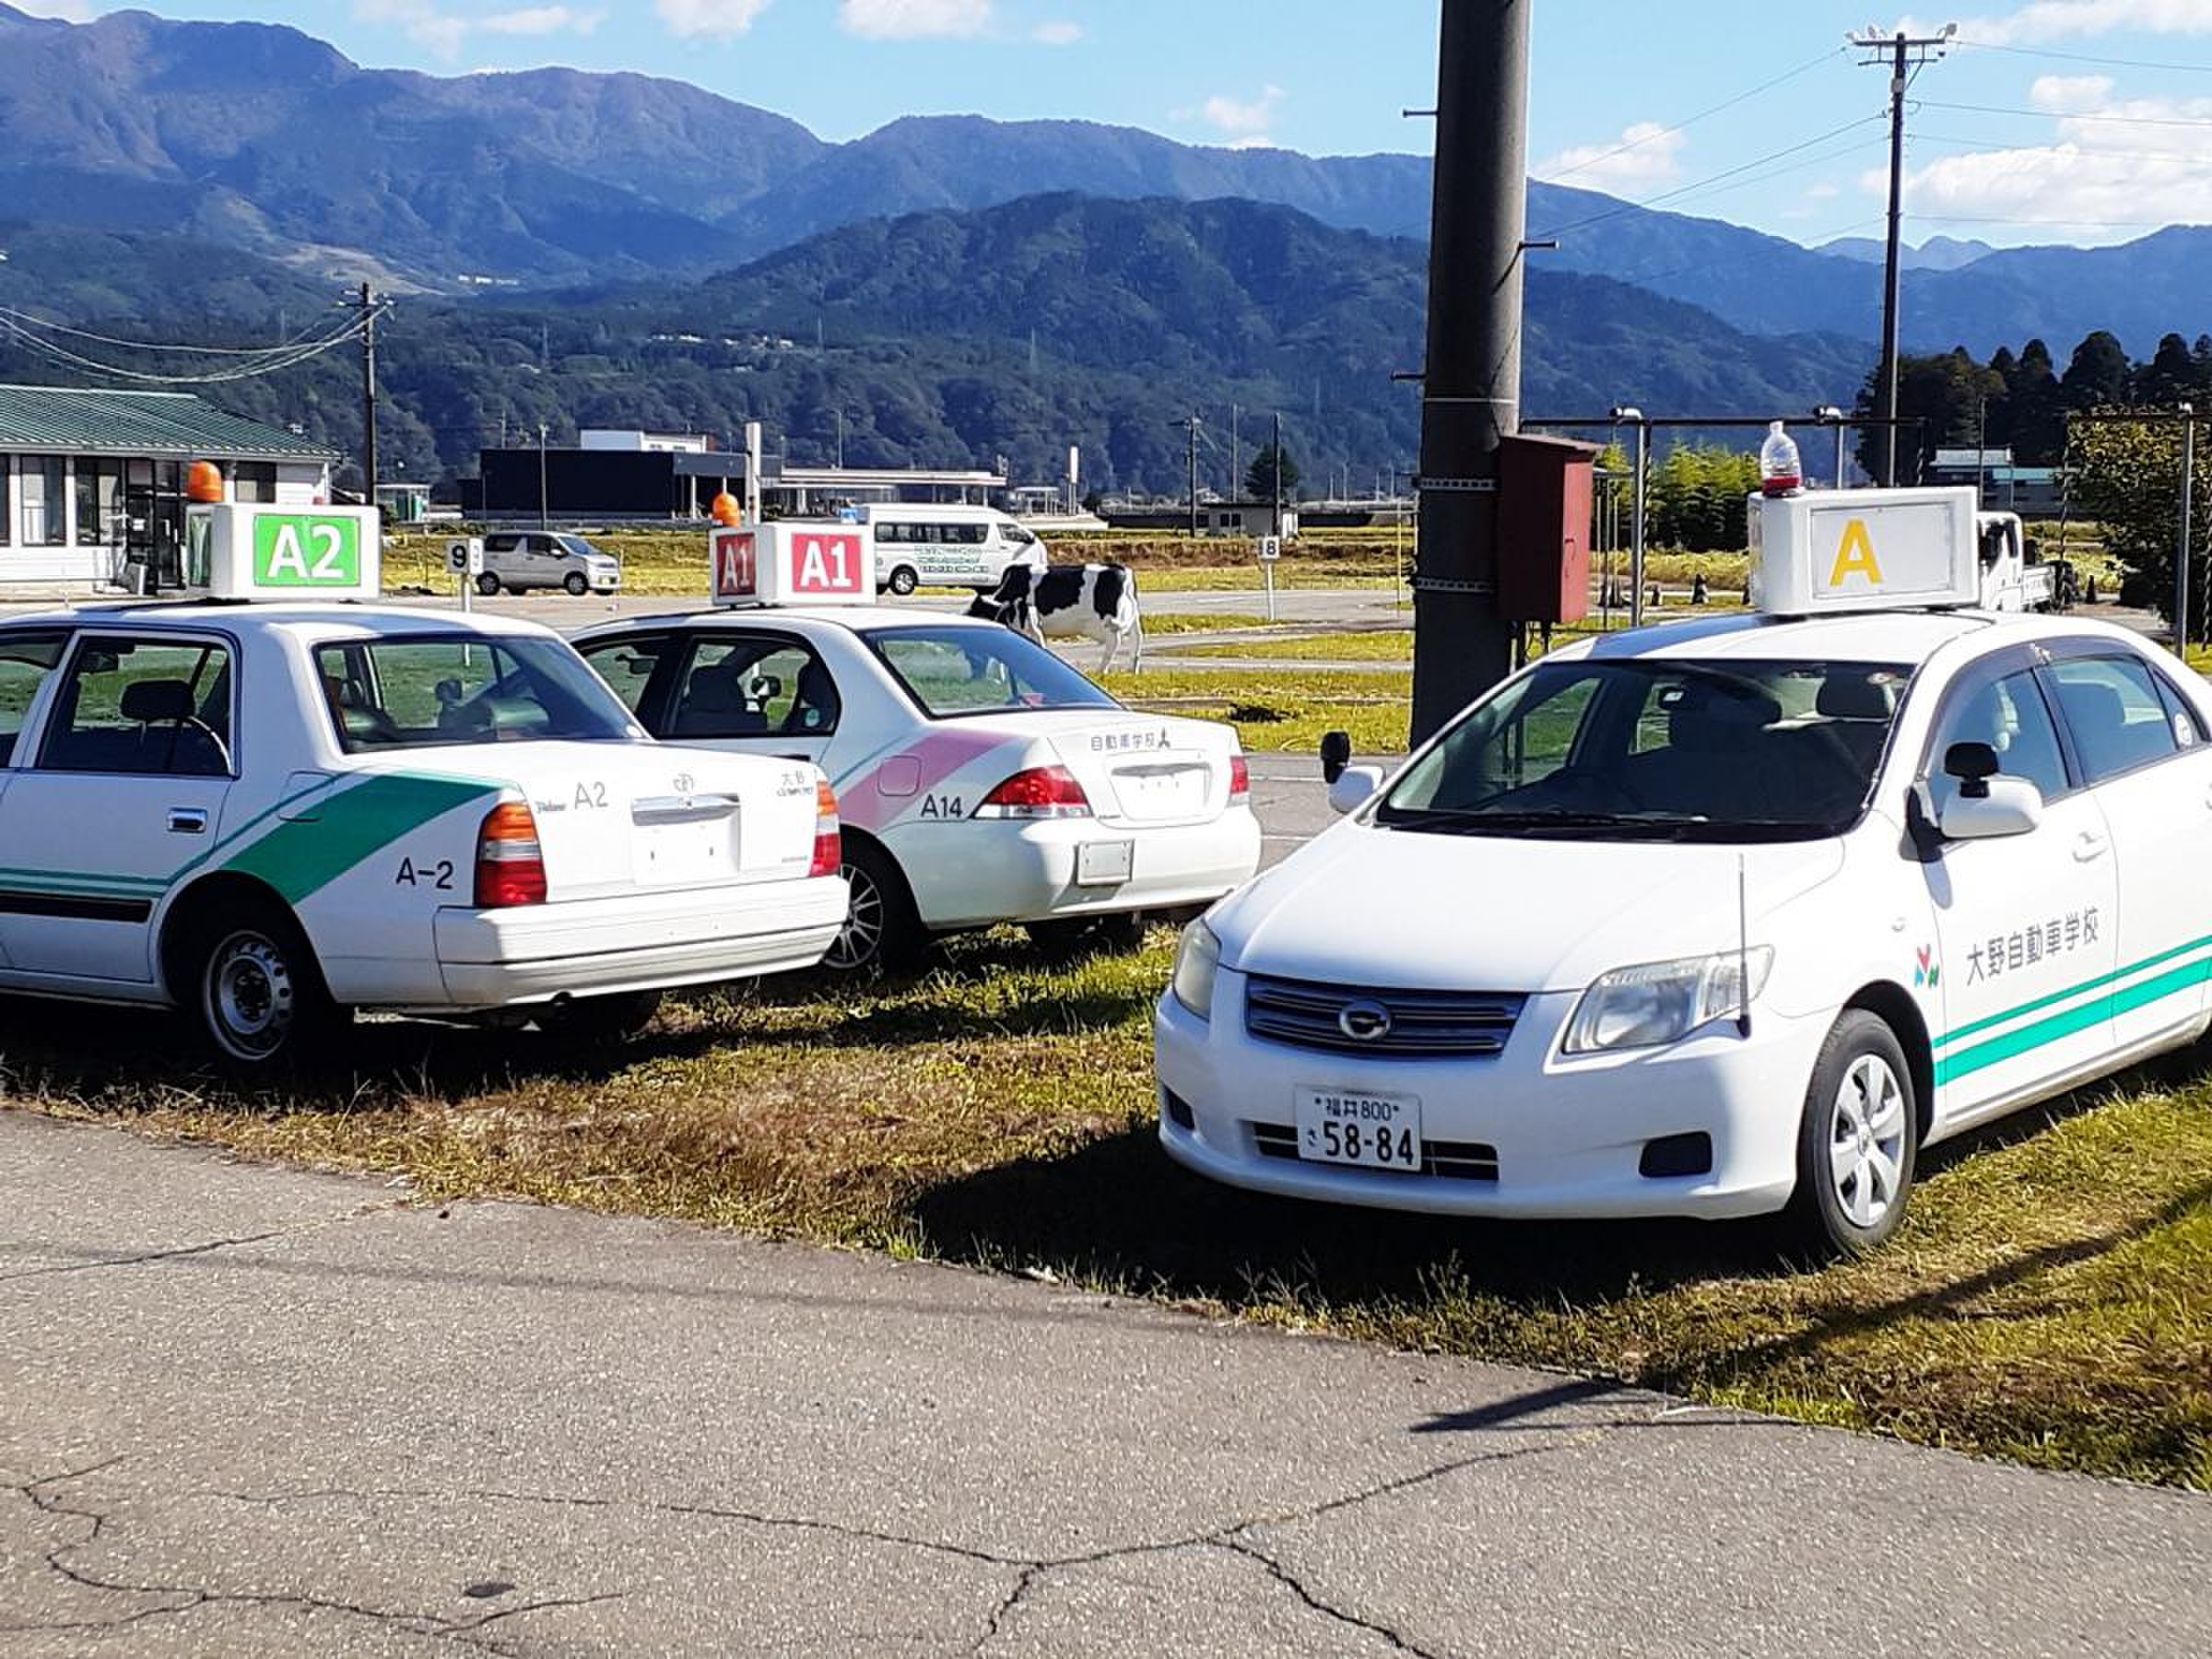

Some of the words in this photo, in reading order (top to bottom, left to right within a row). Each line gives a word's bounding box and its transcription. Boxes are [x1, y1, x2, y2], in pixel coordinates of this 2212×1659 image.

[267, 524, 345, 578] A2
[453, 545, 466, 568] 9
[722, 543, 750, 589] A1
[800, 541, 853, 588] A1
[1830, 517, 1883, 585] A
[574, 782, 608, 809] A2
[921, 794, 963, 818] A14
[396, 857, 454, 889] A-2
[1967, 906, 2099, 987] 大野自動車学校
[1324, 1121, 1414, 1166] 58-84
